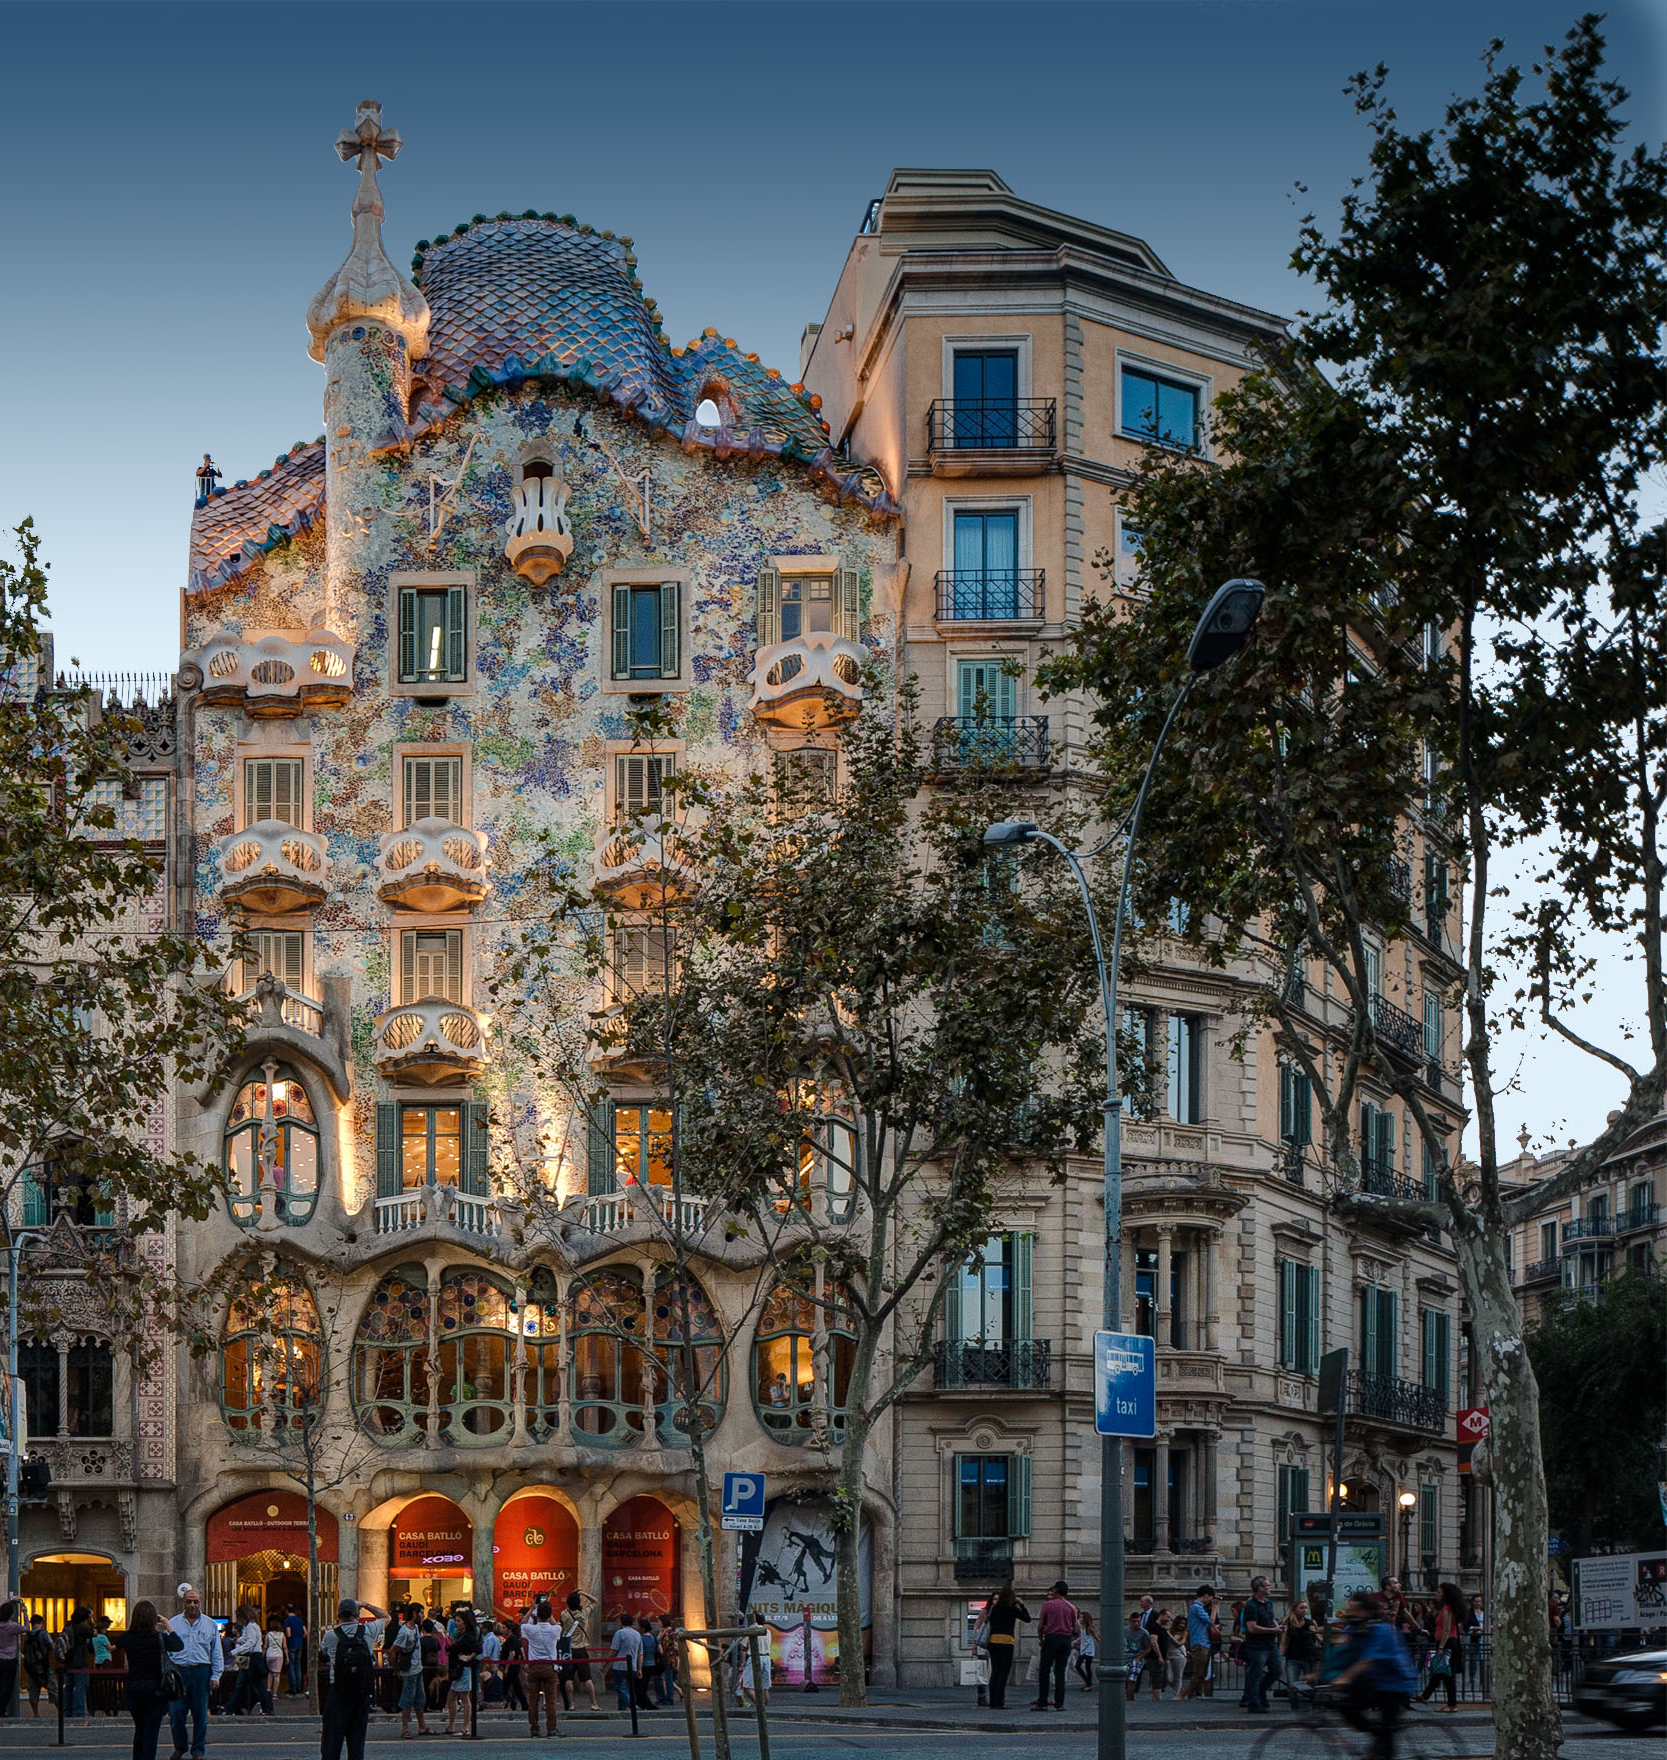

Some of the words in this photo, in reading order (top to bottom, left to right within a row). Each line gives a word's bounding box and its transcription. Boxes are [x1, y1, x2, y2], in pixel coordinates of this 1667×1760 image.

[1116, 1397, 1137, 1415] taxi
[731, 1477, 756, 1510] P
[399, 1532, 425, 1540] CASA
[427, 1530, 463, 1540] BATLLÓ
[606, 1532, 632, 1540] CASA
[634, 1530, 670, 1540] BATLLÓ
[607, 1550, 663, 1558] BARCELONA
[502, 1571, 529, 1580] CASA
[530, 1570, 565, 1580] BATLLÓ
[748, 1602, 779, 1613] NITS
[783, 1600, 838, 1613] MÀGIQU
